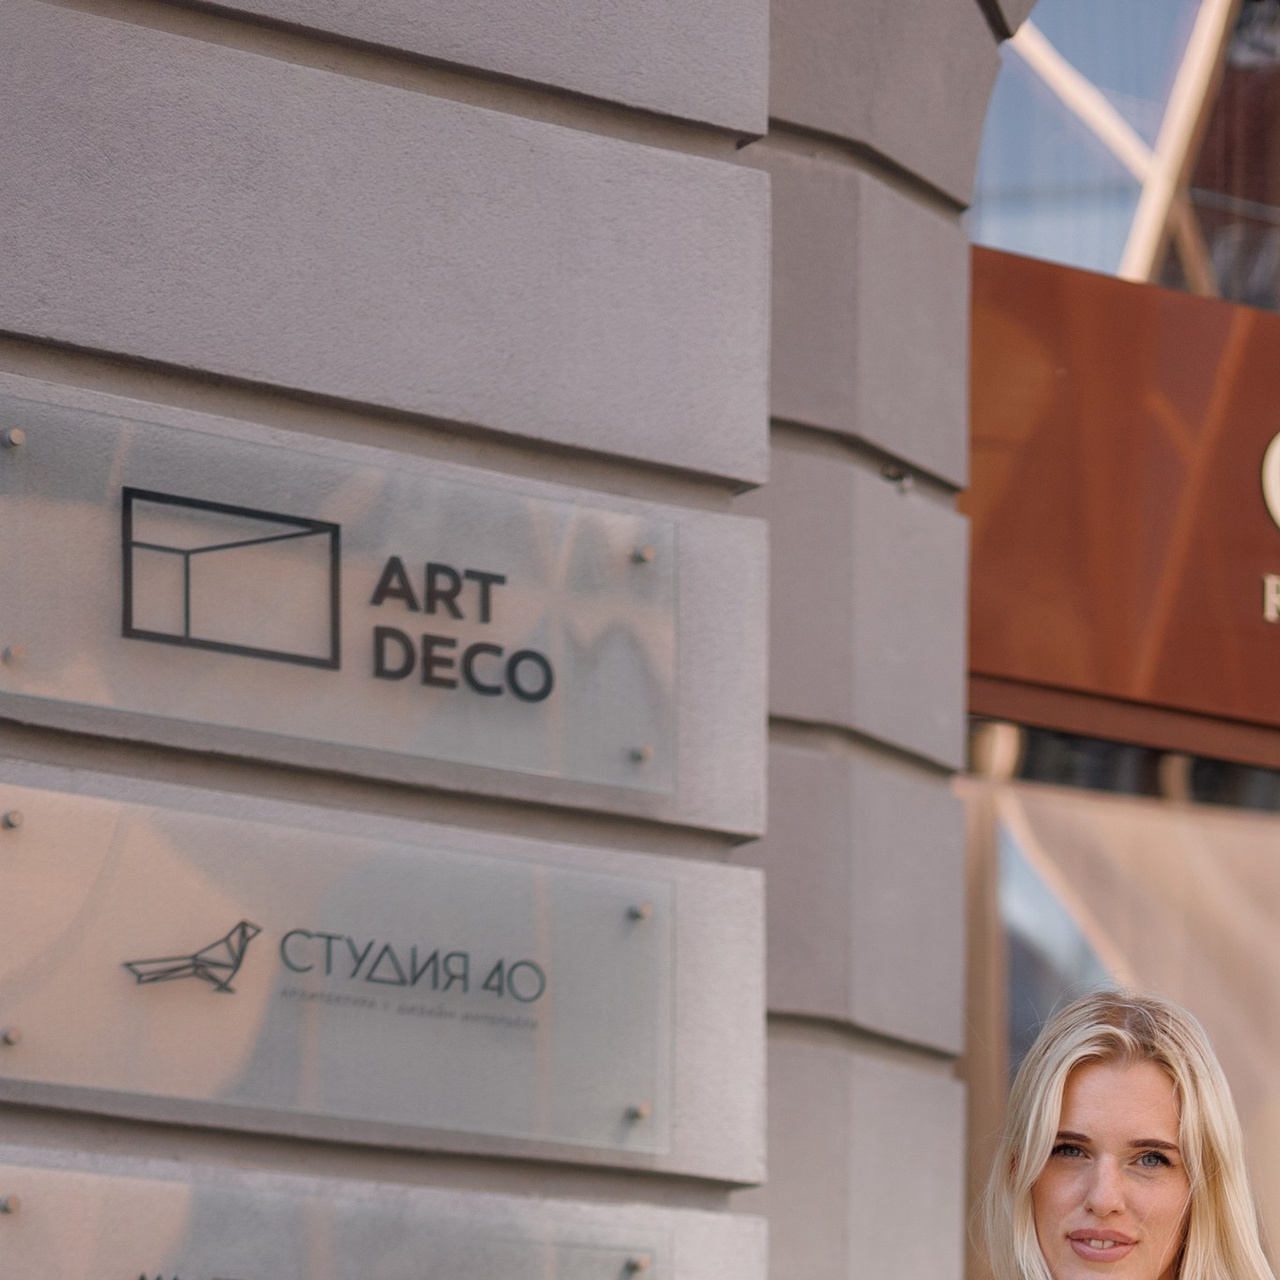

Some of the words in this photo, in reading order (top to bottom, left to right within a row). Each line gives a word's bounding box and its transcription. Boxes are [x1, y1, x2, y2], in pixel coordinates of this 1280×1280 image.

[370, 555, 507, 624] ART
[373, 625, 554, 703] DECO
[280, 928, 470, 994] СТУДИЯ
[481, 958, 546, 1003] 40
